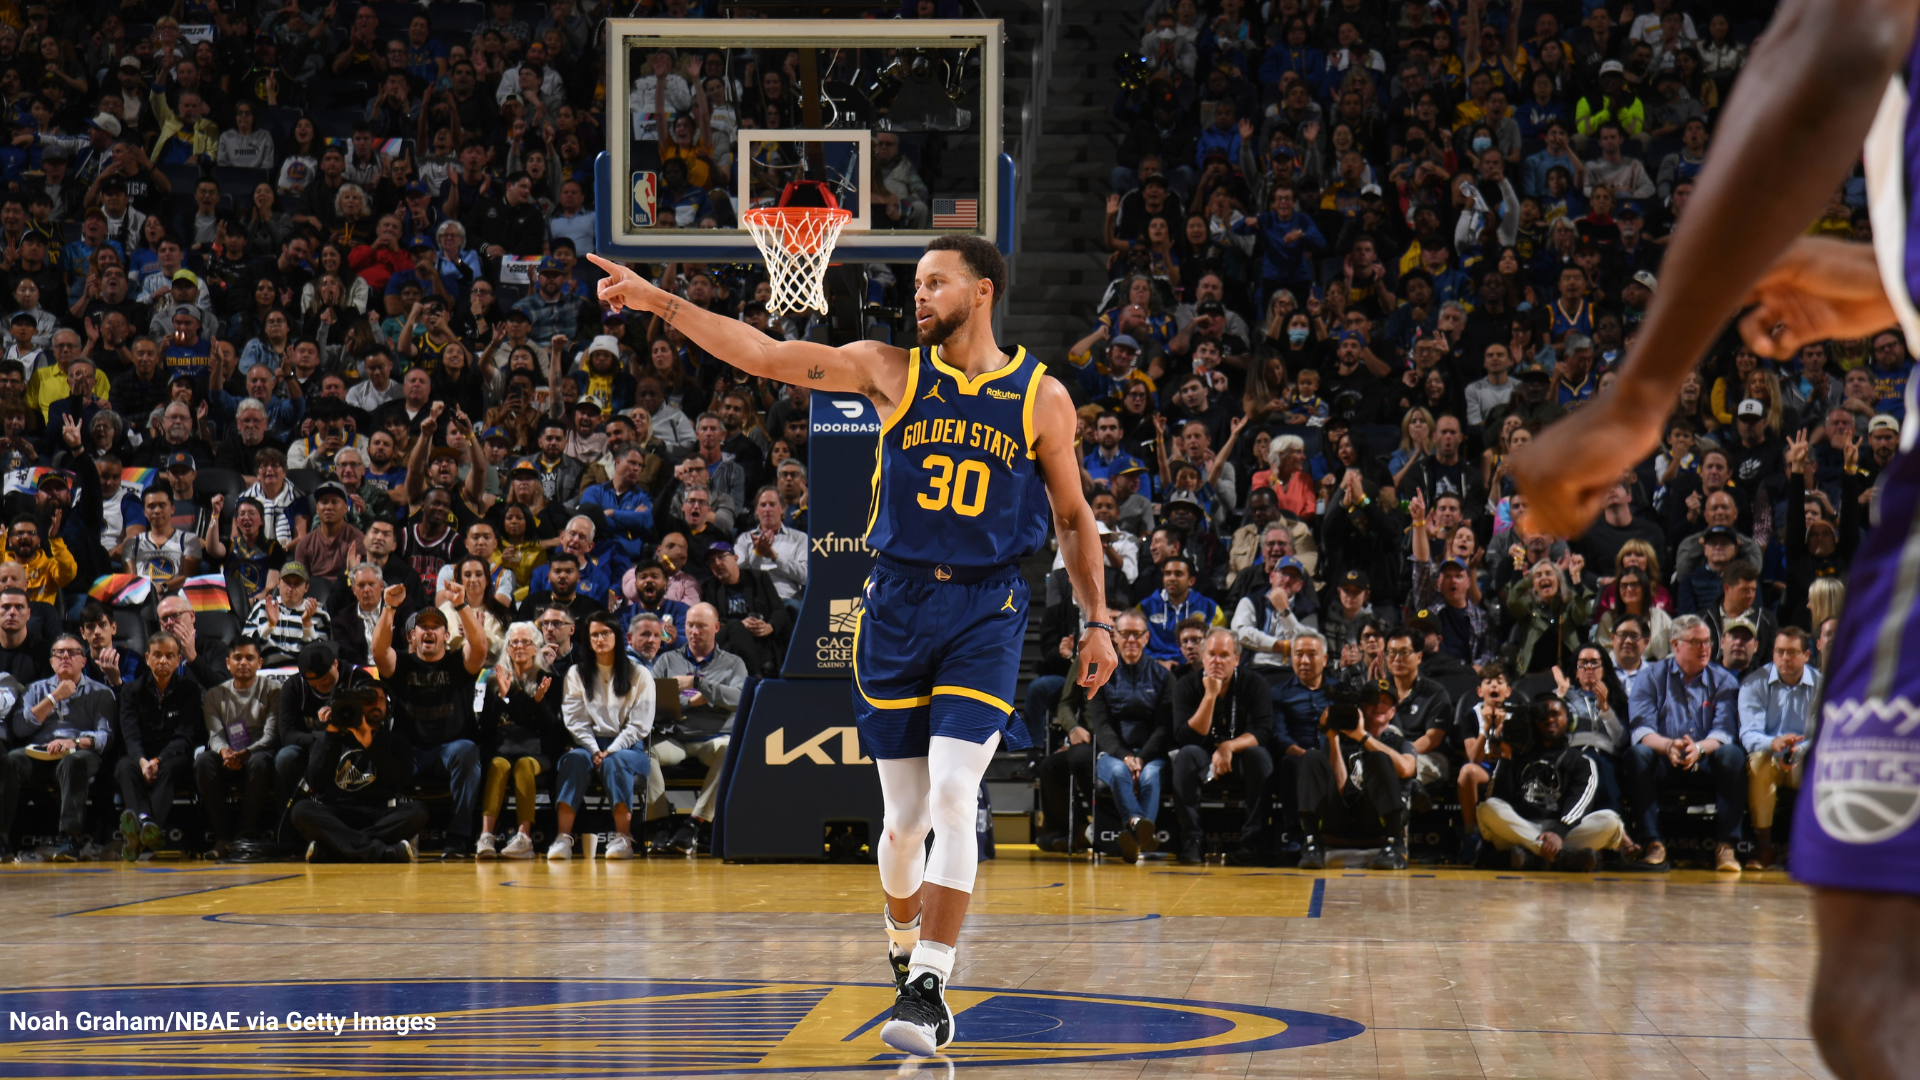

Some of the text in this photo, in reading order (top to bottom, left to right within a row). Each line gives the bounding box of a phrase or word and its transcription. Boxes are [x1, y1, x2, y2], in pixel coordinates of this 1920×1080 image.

[635, 214, 647, 223] NBA
[986, 387, 1021, 400] Rakuten
[902, 418, 1019, 470] GOLDEN STATE
[917, 454, 991, 517] 30
[816, 636, 854, 649] CAC
[816, 649, 852, 661] CRE
